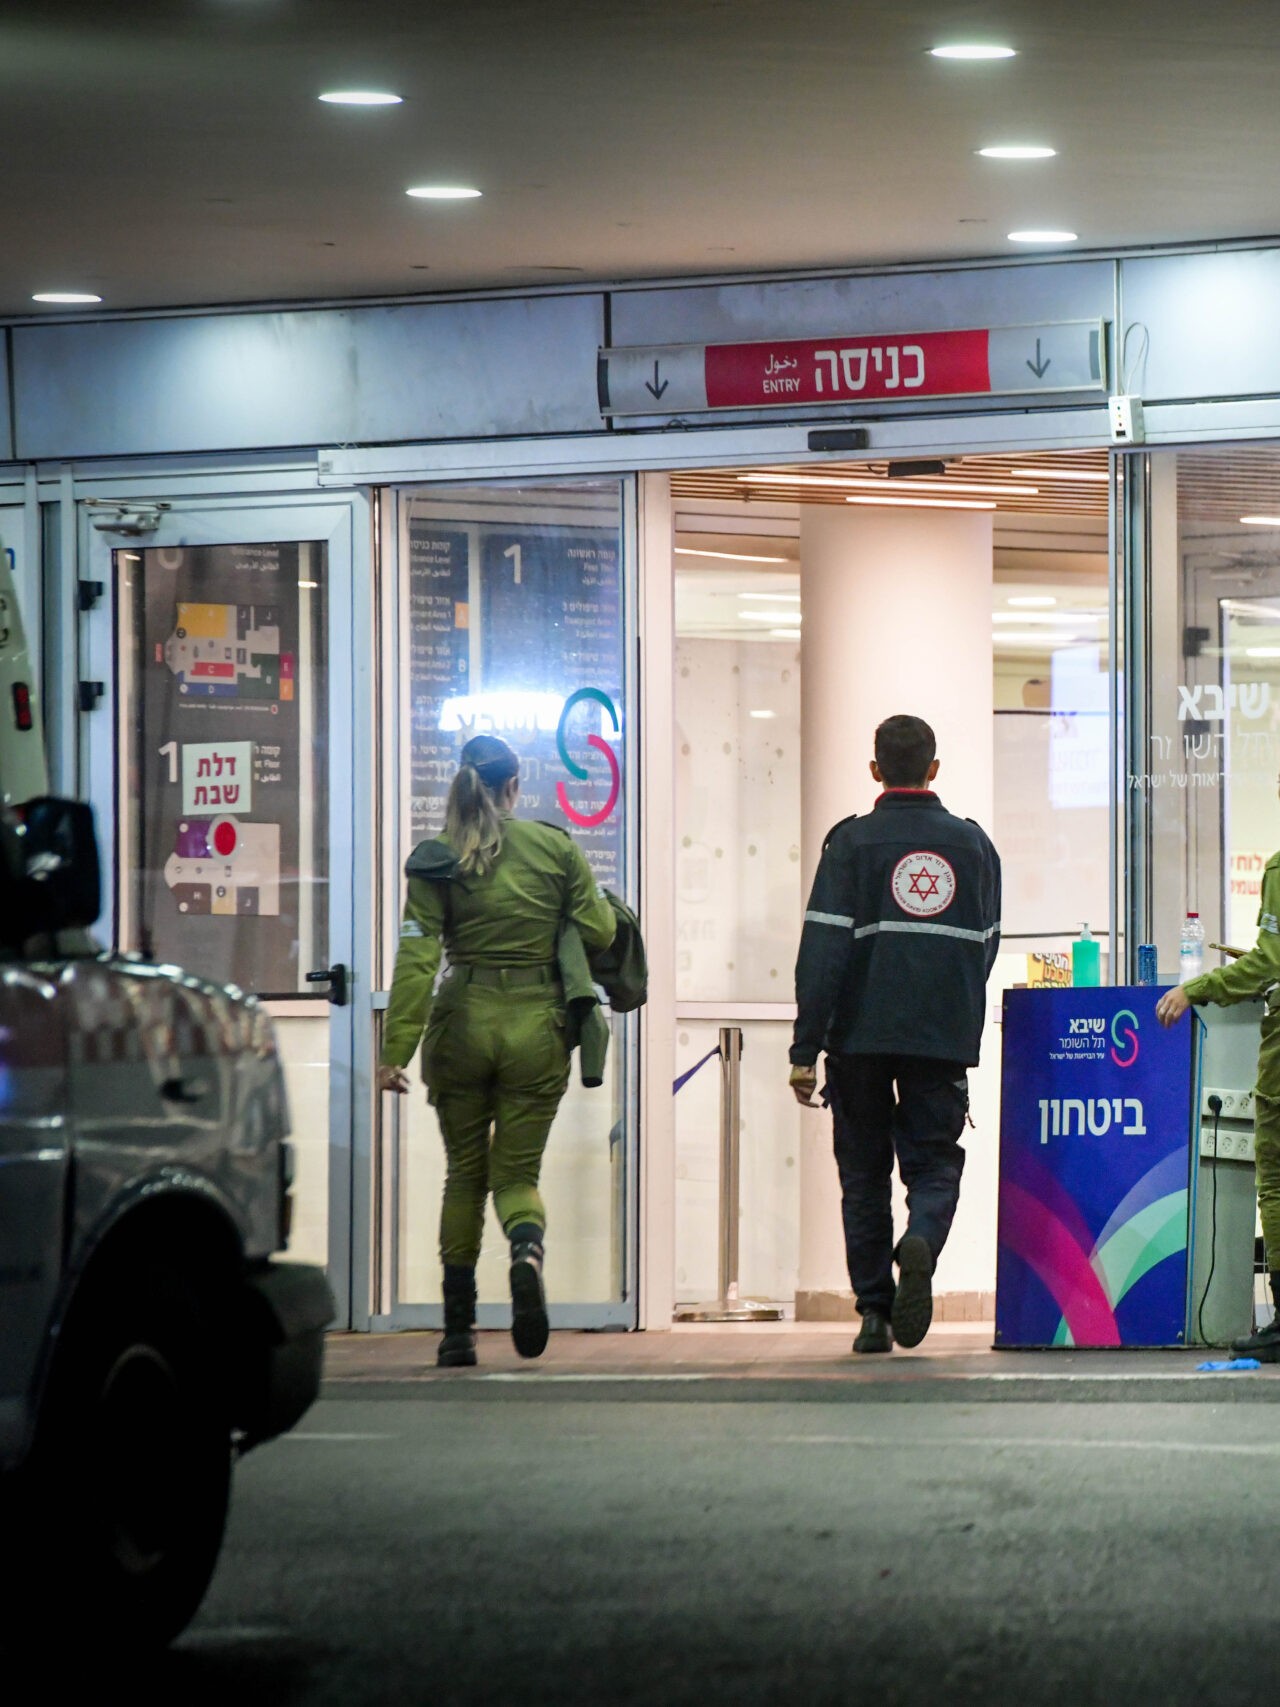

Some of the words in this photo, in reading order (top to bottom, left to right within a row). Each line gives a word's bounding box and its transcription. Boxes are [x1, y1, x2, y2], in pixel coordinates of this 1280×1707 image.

[765, 353, 798, 375] دخول
[814, 345, 925, 392] כניסה
[763, 378, 800, 394] ENTRY
[504, 544, 521, 584] 1
[1177, 682, 1270, 721] שיבא
[158, 741, 177, 783] 1
[197, 752, 236, 777] דלת
[1169, 770, 1188, 787] של
[194, 784, 240, 806] שבת
[1069, 1018, 1106, 1034] שיבא
[1059, 1037, 1090, 1049] השומר
[1092, 1035, 1106, 1049] תל
[1039, 1098, 1147, 1144] ביטחון
